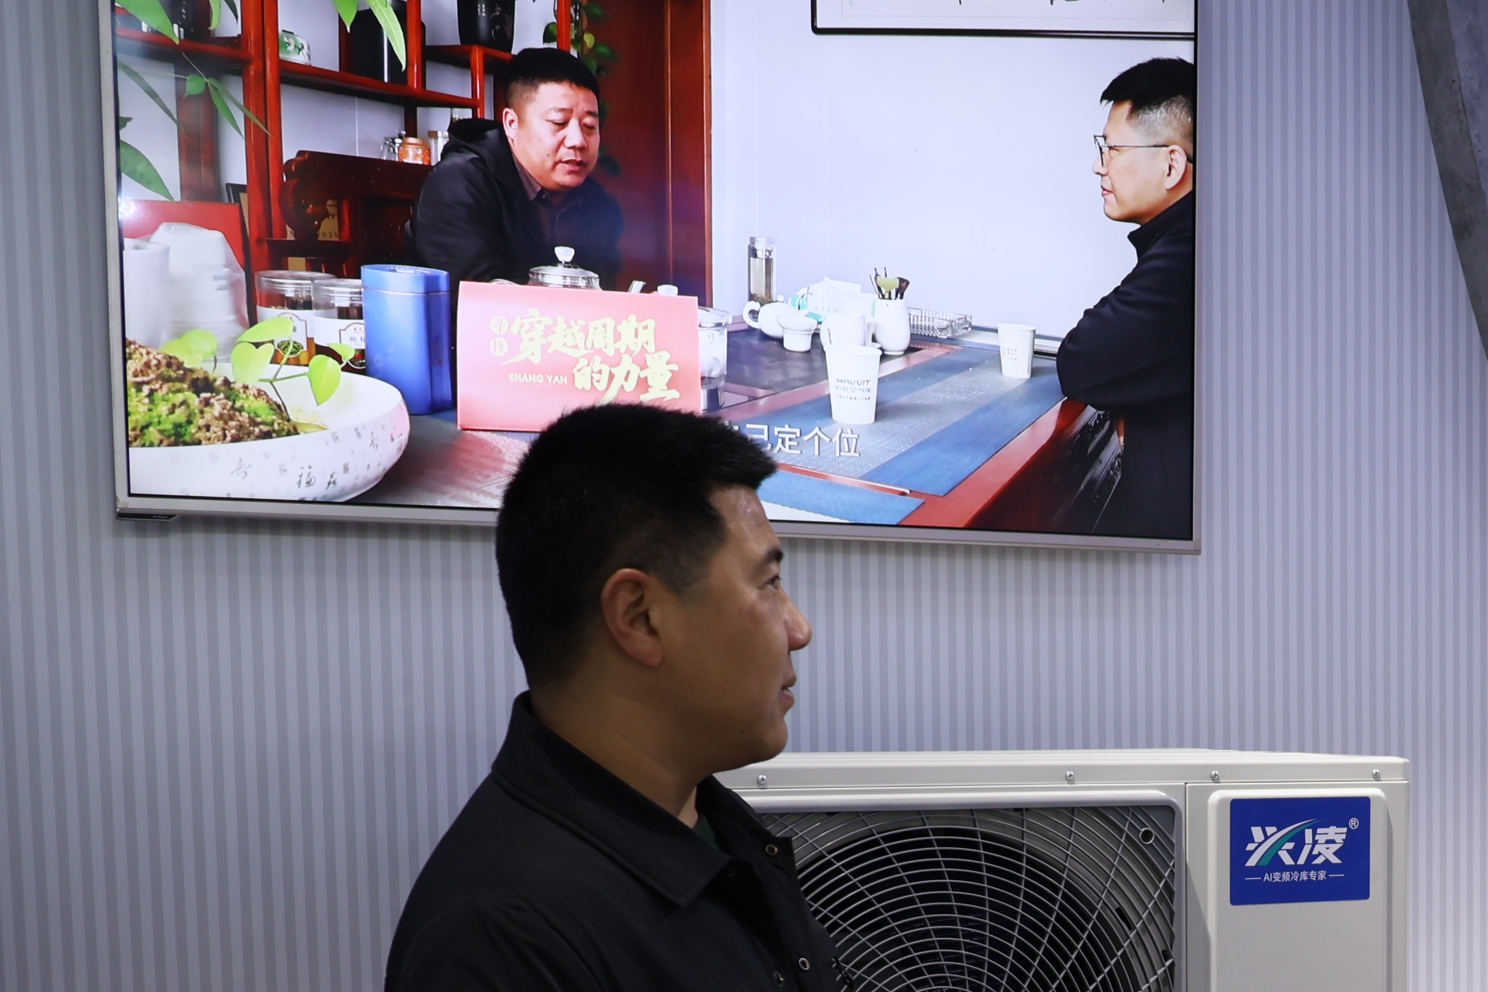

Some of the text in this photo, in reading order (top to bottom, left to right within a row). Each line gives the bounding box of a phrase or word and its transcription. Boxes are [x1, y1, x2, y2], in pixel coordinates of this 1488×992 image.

[508, 373, 568, 384] SHANG YAN
[572, 350, 681, 406] 的力量
[1263, 870, 1328, 882] AI变频冷库专家
